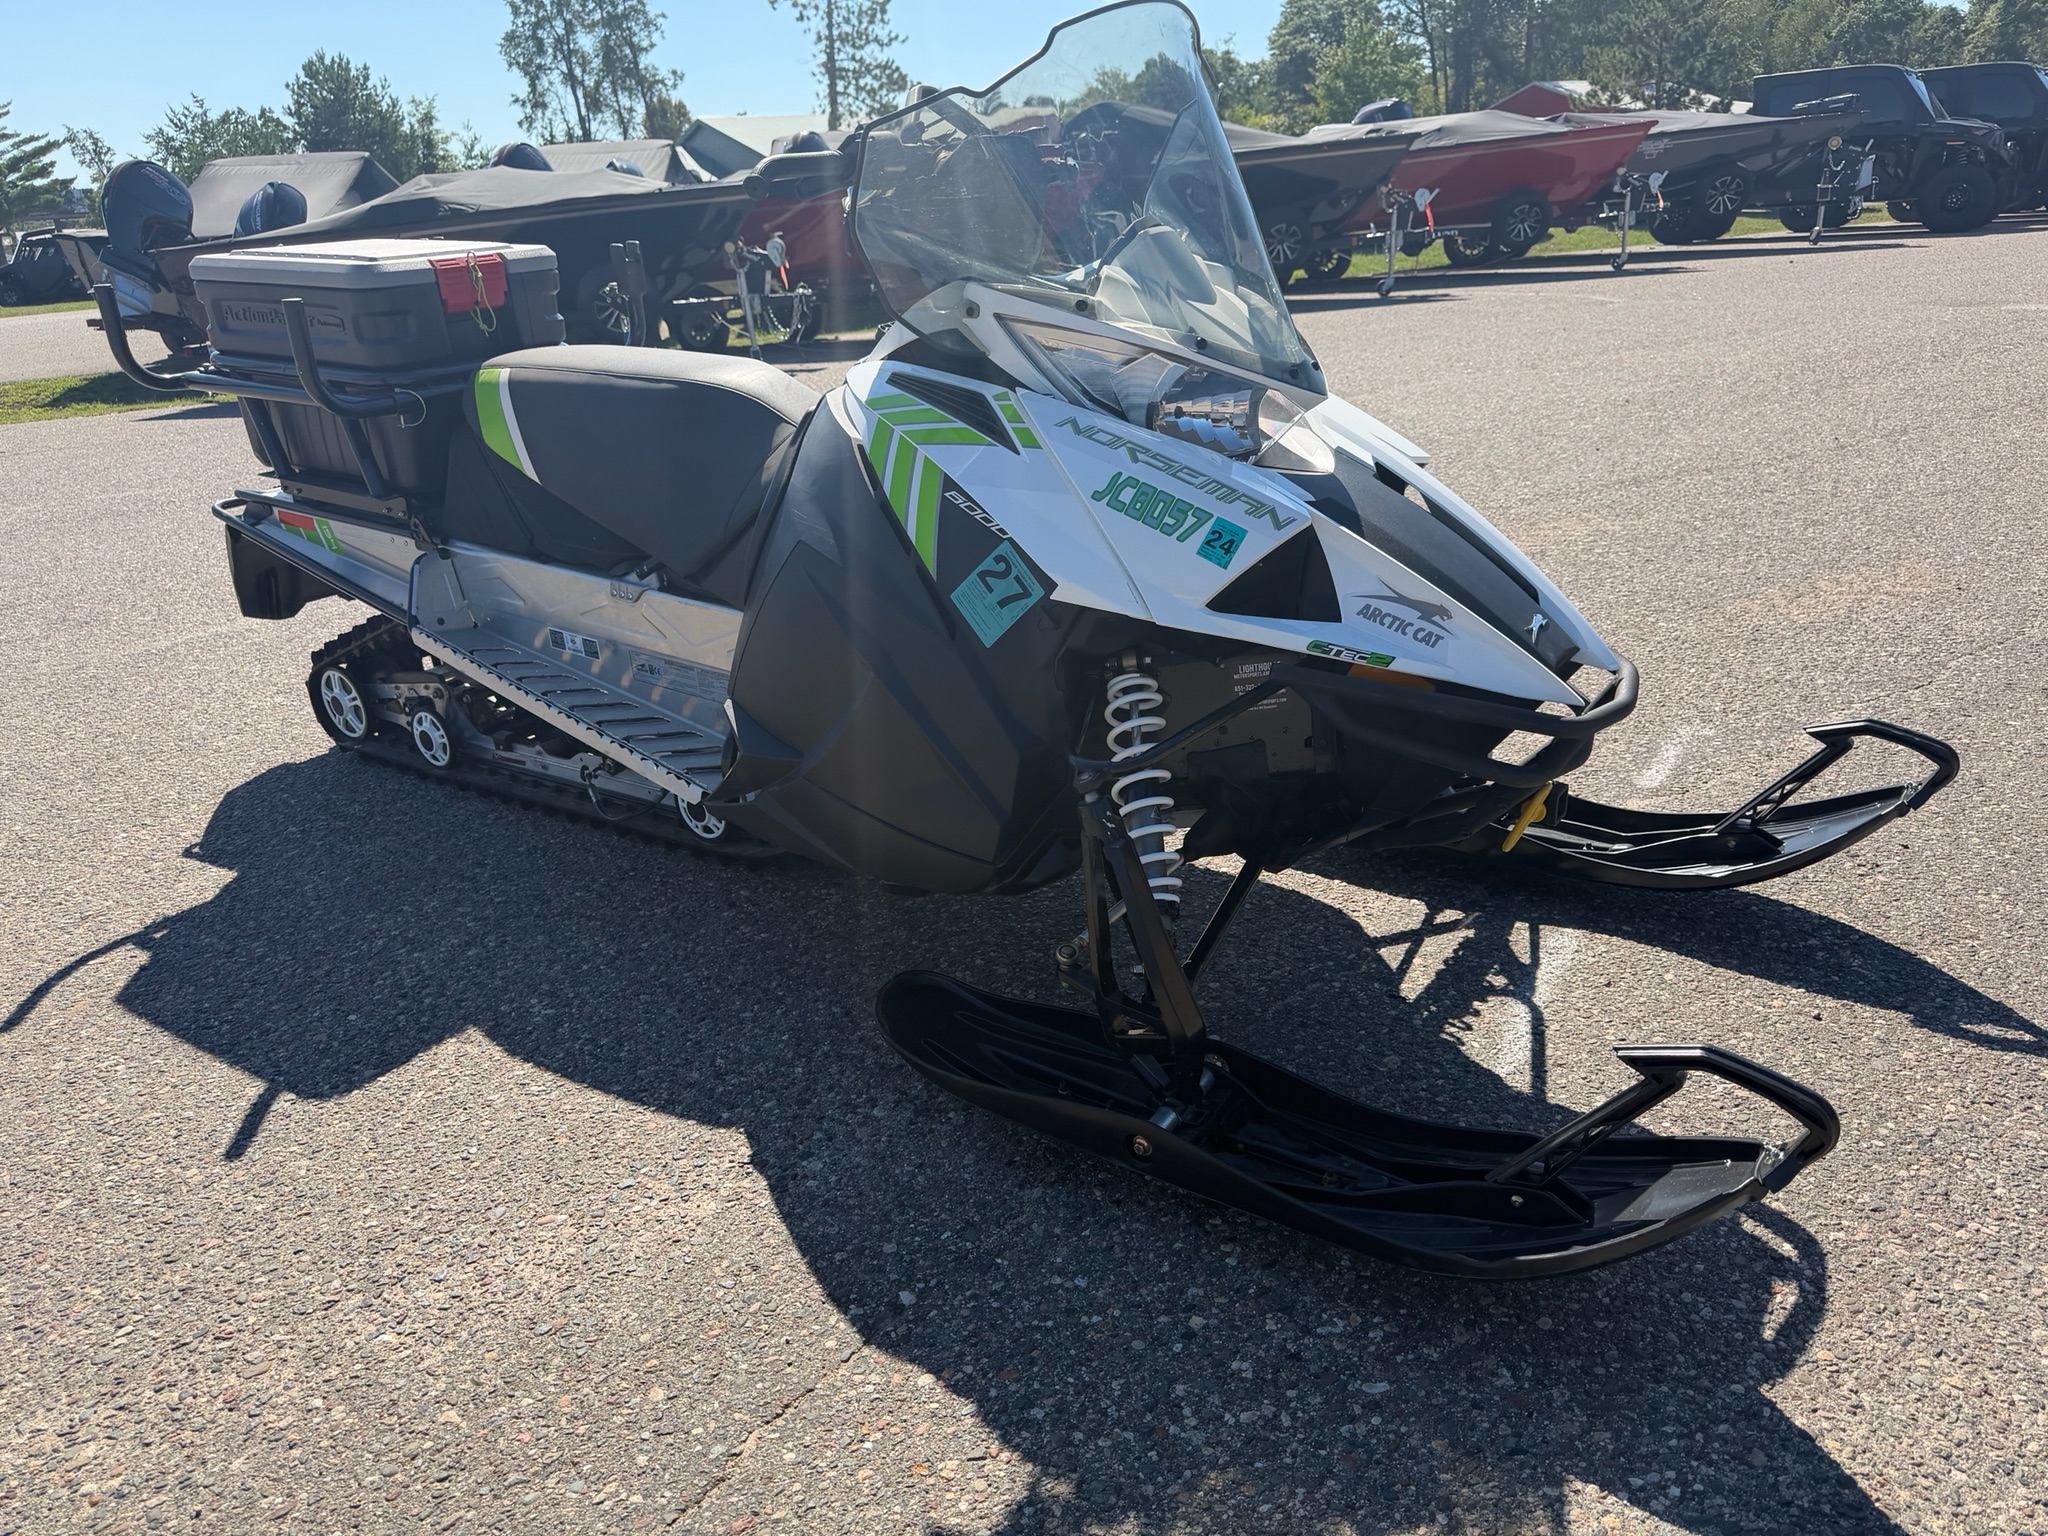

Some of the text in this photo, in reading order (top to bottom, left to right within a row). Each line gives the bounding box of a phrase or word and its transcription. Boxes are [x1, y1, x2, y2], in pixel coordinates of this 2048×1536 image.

[224, 305, 315, 327] ActionPar
[1053, 415, 1298, 531] NORSEMAN
[1204, 529, 1236, 556] 24
[976, 553, 1033, 609] 27
[1356, 603, 1445, 648] ARCTIC CAT
[1239, 661, 1280, 673] LIGHTHOU
